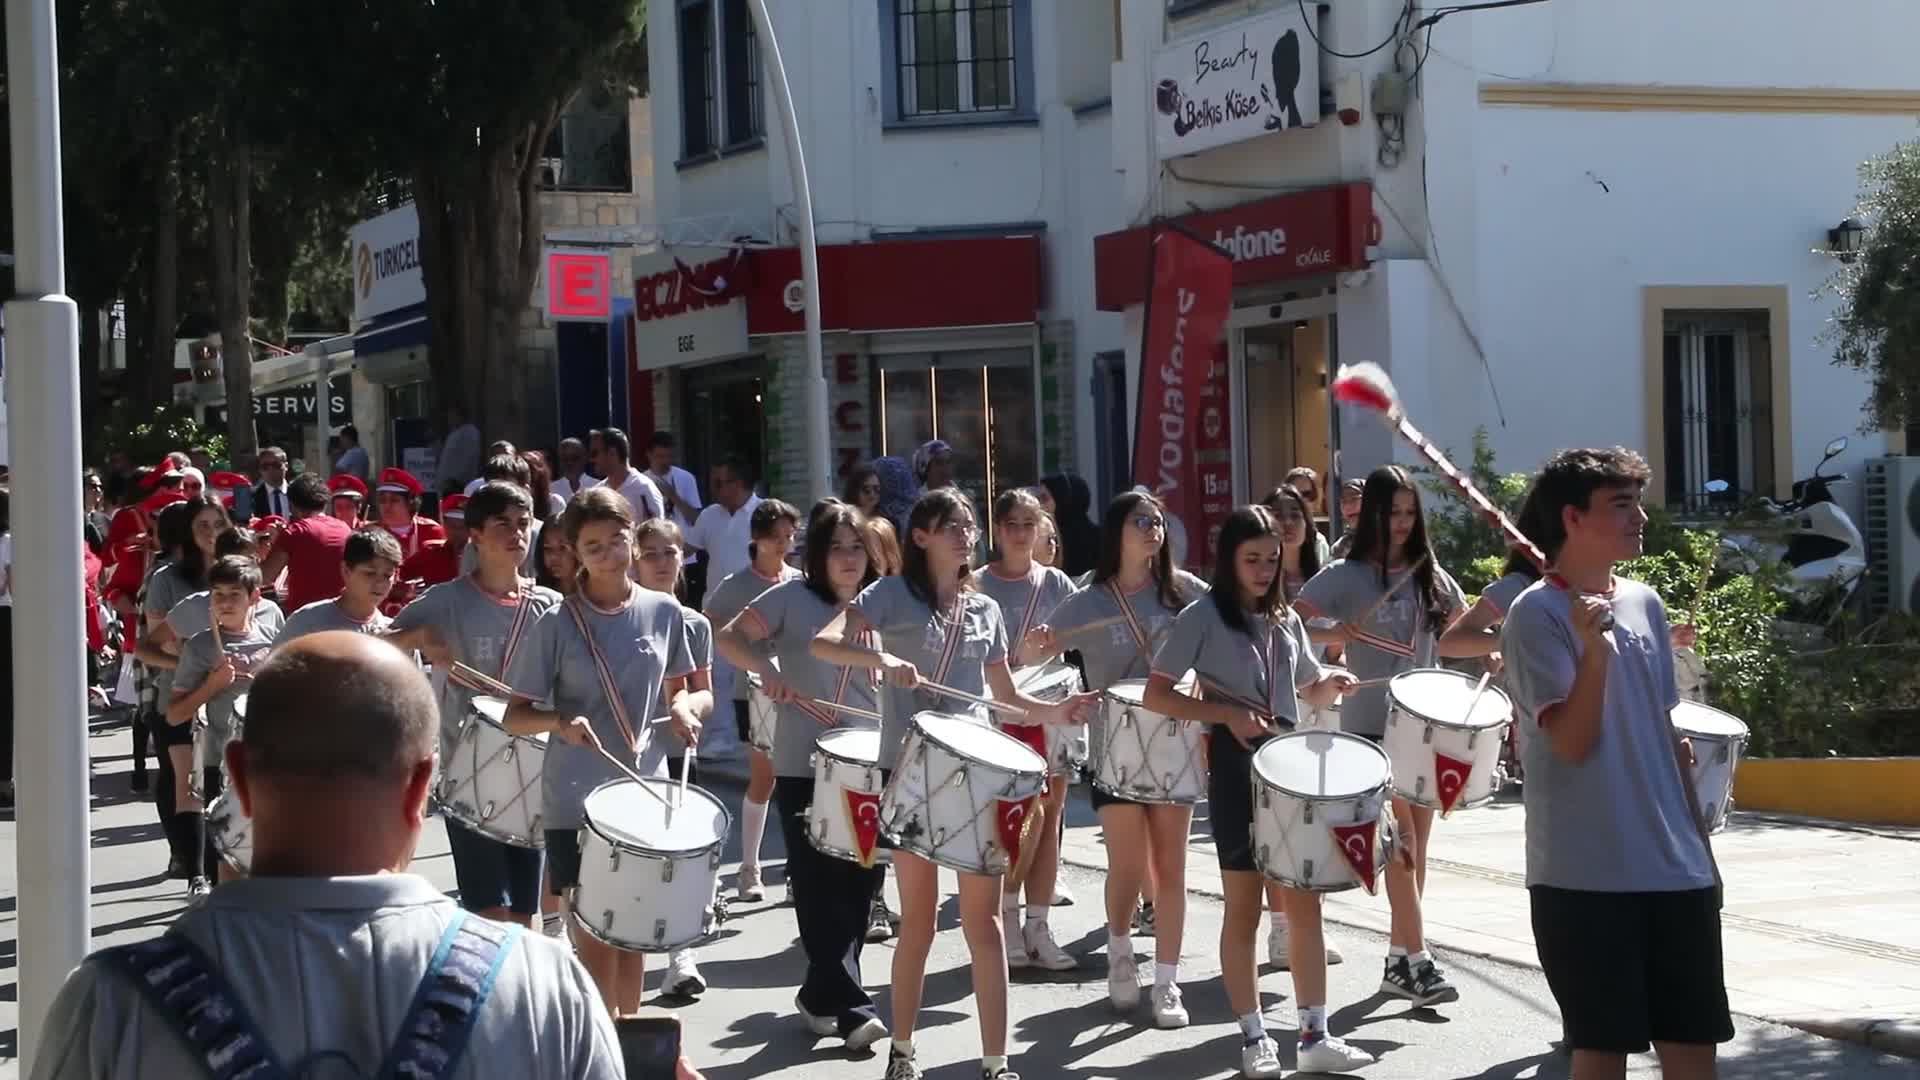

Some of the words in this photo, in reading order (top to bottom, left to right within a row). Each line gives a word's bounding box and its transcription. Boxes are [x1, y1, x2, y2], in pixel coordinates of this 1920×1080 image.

[1195, 32, 1258, 85] Beauty
[1225, 89, 1260, 120] Köse
[373, 239, 419, 280] TURKCEL
[563, 264, 597, 307] E
[677, 334, 695, 353] EGE
[253, 396, 345, 414] SERVS
